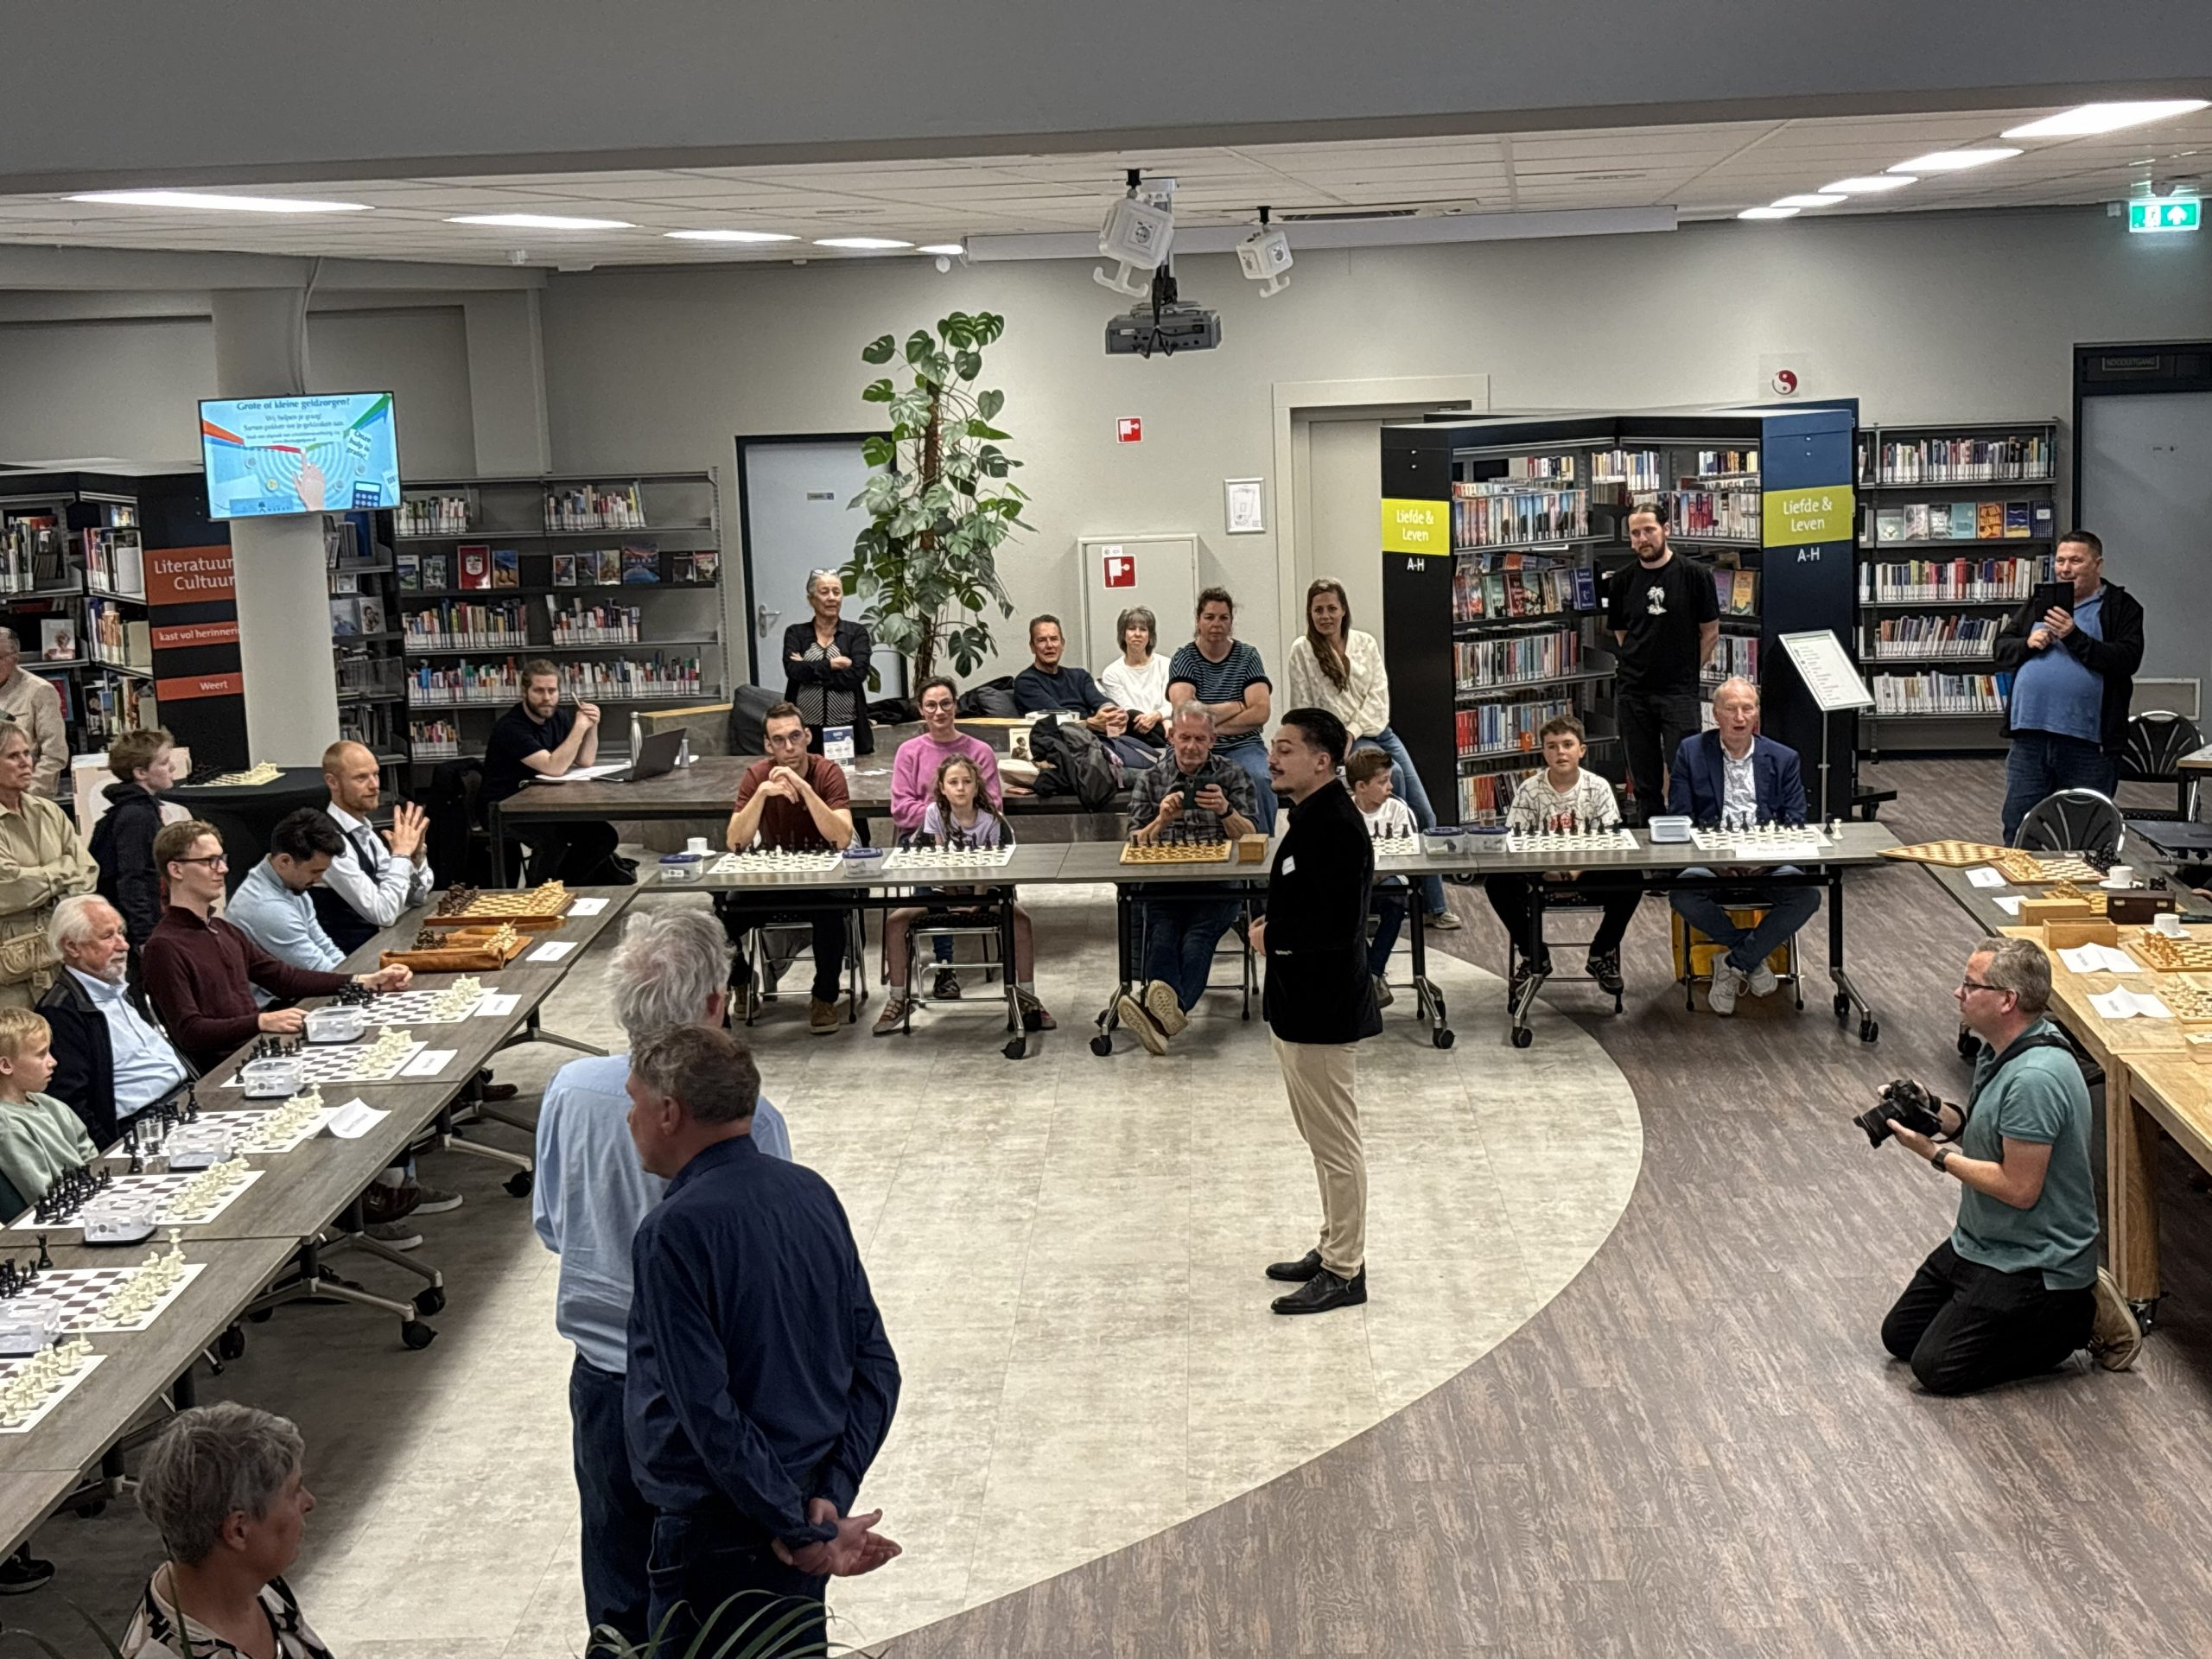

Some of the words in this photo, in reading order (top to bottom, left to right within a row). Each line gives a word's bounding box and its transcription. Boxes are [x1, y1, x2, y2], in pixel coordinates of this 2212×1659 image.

[237, 402, 262, 410] Grote
[264, 401, 272, 410] of
[275, 400, 299, 409] kleine
[354, 431, 372, 443] Onze
[1783, 498, 1819, 515] Liefde
[1821, 496, 1833, 512] &
[1396, 509, 1424, 524] Liefde
[1425, 510, 1434, 525] &
[1791, 518, 1826, 532] Leven
[1402, 527, 1428, 542] Leven
[1797, 547, 1820, 563] A-H
[154, 557, 233, 575] Literatuur
[1407, 557, 1424, 571] A-H
[174, 575, 235, 591] Cultuur
[159, 632, 179, 641] kast
[180, 630, 194, 640] vol
[200, 681, 228, 691] Weert
